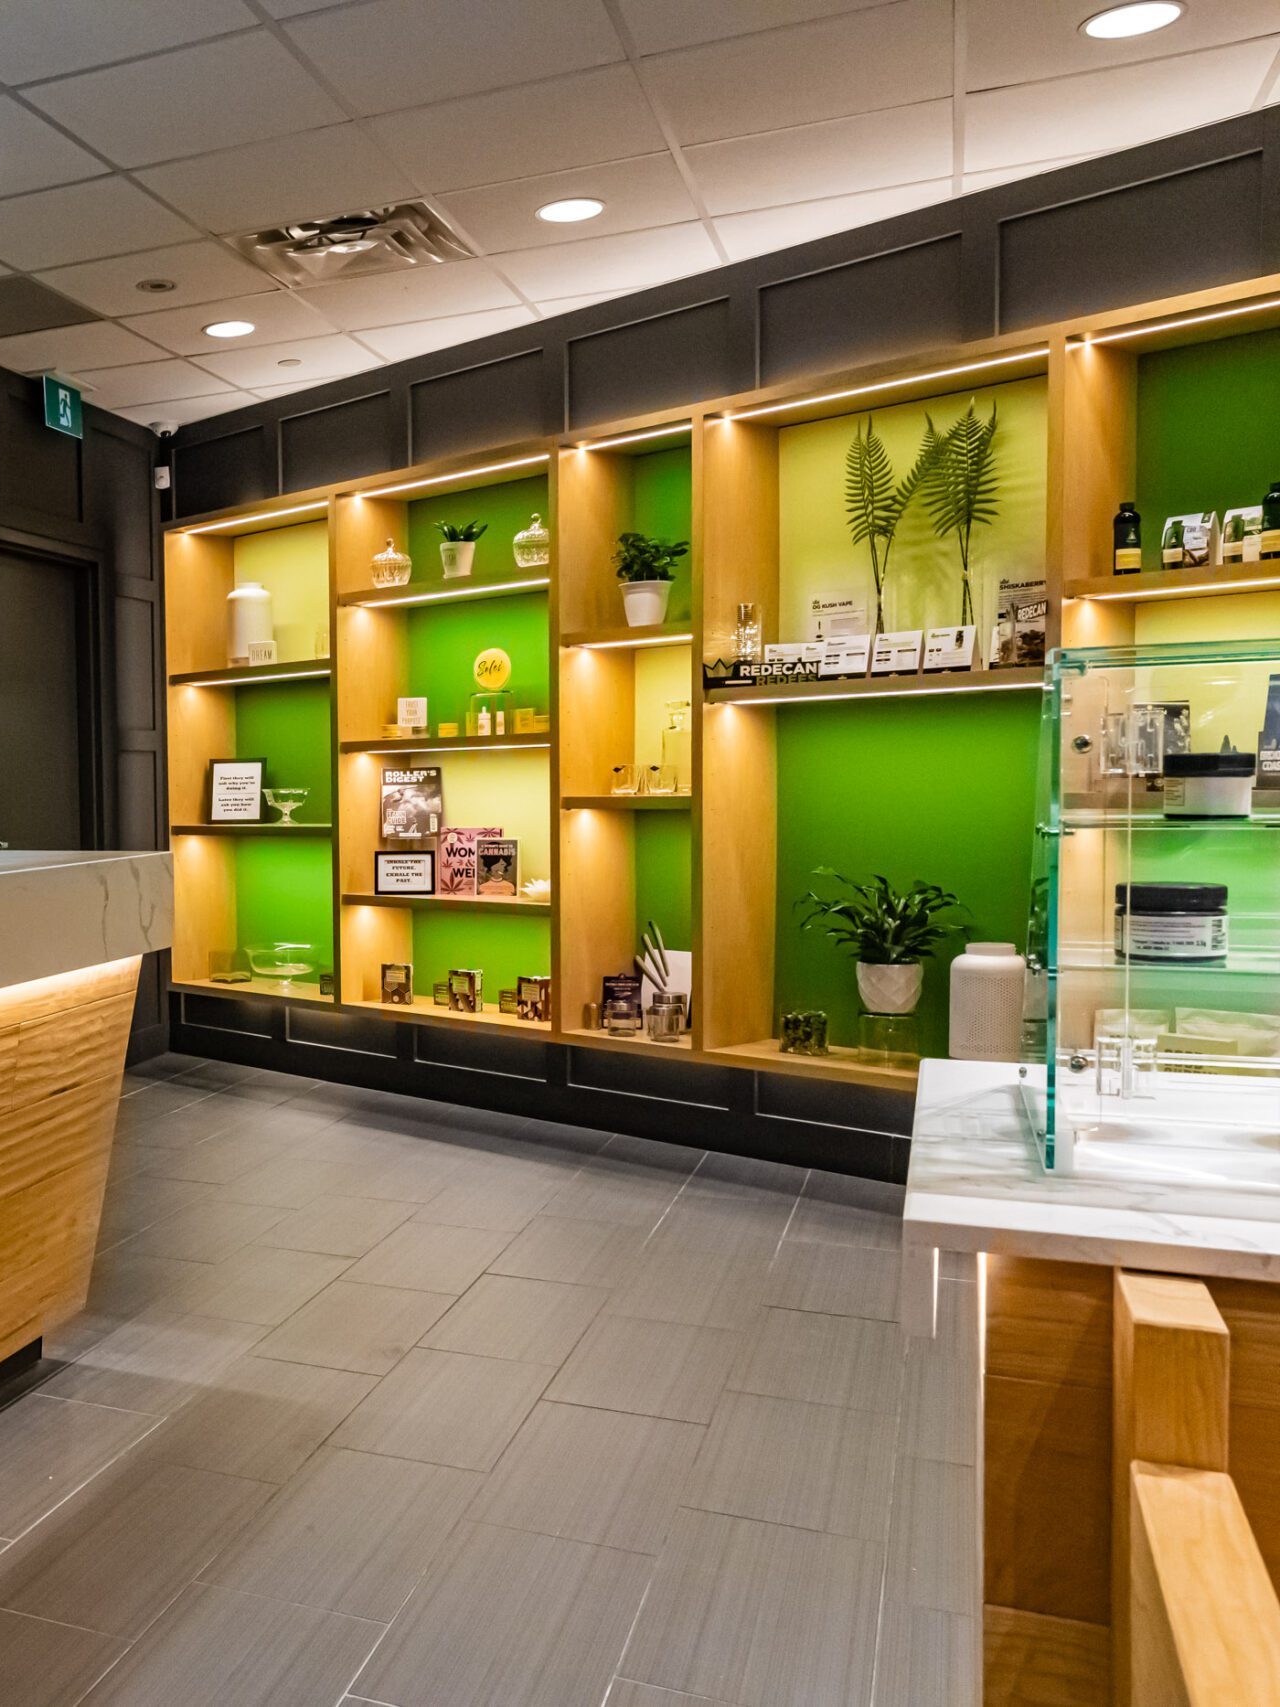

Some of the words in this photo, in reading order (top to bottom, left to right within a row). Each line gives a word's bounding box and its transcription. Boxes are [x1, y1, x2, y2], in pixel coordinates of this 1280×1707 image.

[1017, 601, 1047, 620] REDECAN
[251, 649, 273, 662] DREAM
[740, 662, 818, 677] REDECAN
[478, 848, 516, 856] CANNABIS
